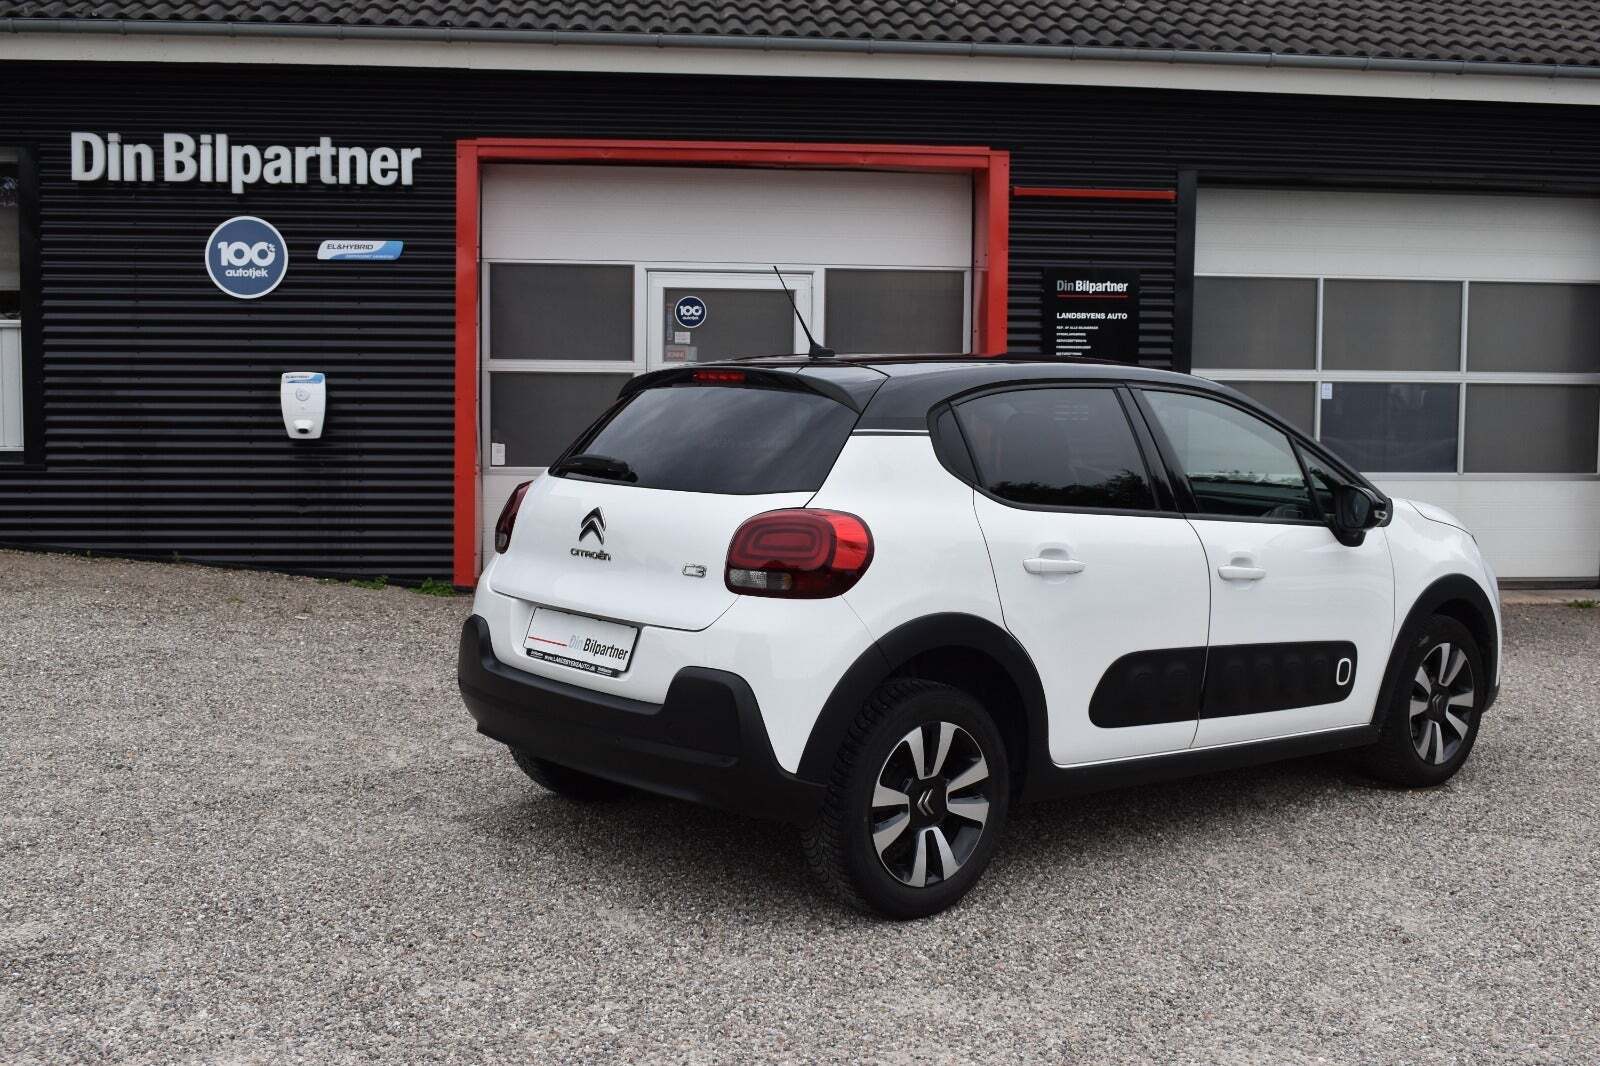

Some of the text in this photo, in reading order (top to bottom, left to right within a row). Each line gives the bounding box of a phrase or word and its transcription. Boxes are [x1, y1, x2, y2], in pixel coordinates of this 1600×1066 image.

[70, 131, 421, 194] Din Bilpartner
[225, 267, 269, 279] autotjek
[1056, 280, 1128, 294] Din Bilpartner
[1056, 312, 1128, 320] LANDSBYENS AUTO
[682, 564, 707, 578] C3
[583, 637, 629, 661] Bilpartner
